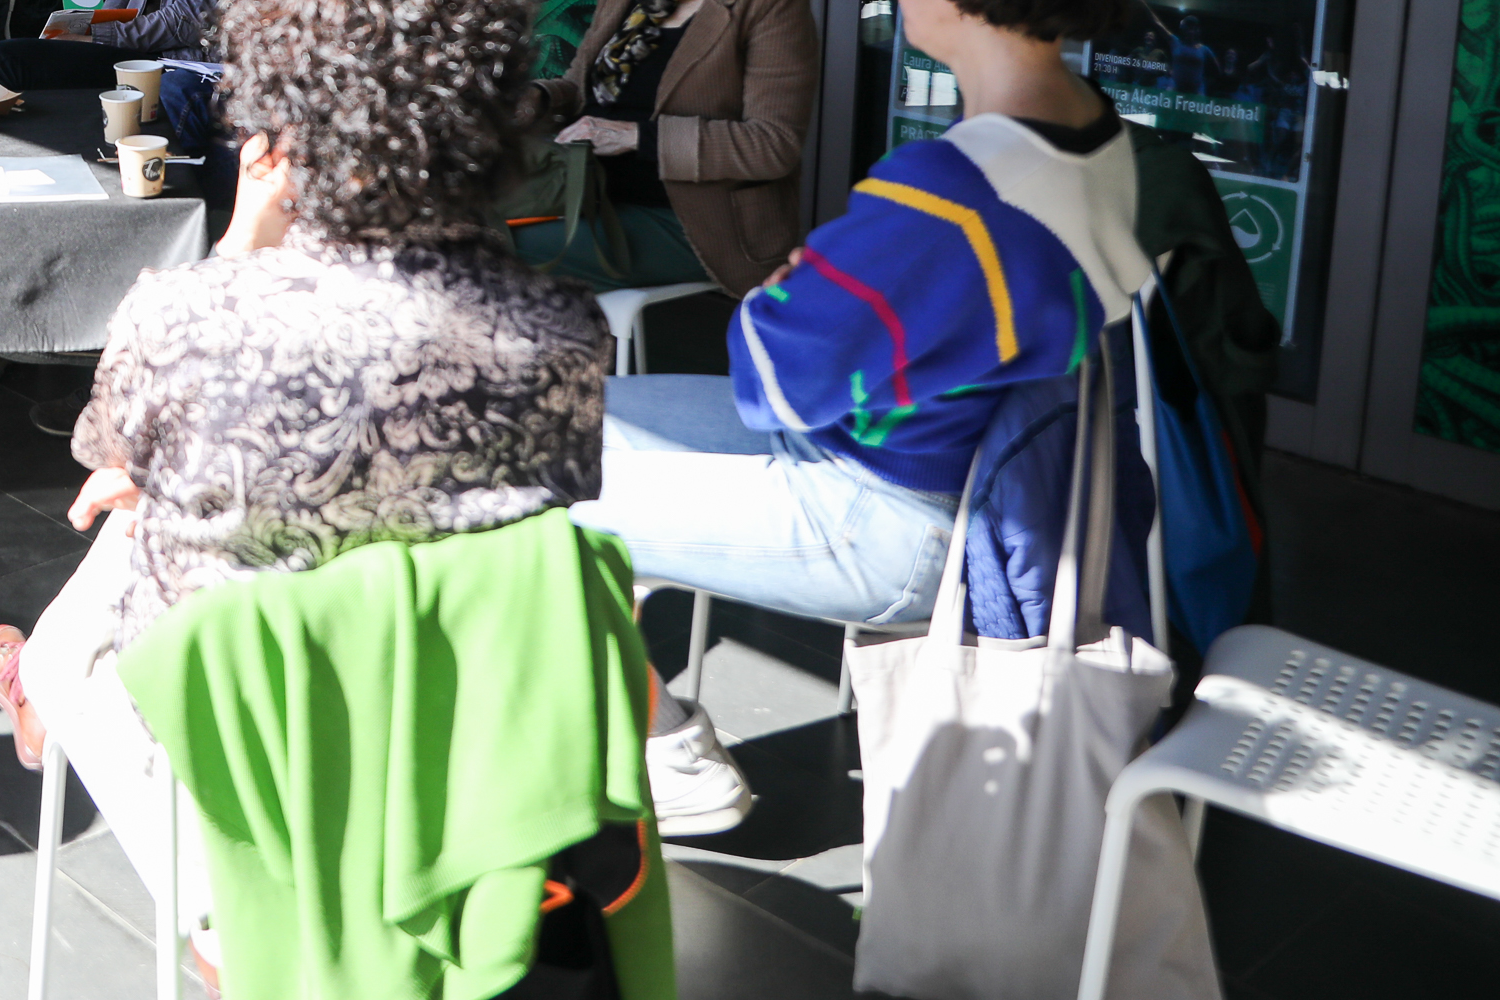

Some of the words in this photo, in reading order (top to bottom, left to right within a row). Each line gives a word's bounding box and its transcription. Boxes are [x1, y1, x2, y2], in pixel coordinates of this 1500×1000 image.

[903, 51, 931, 70] Laura
[1094, 52, 1131, 67] DIVENDRES
[1141, 60, 1167, 72] D'ABRIL
[1174, 94, 1260, 122] Freudenthal
